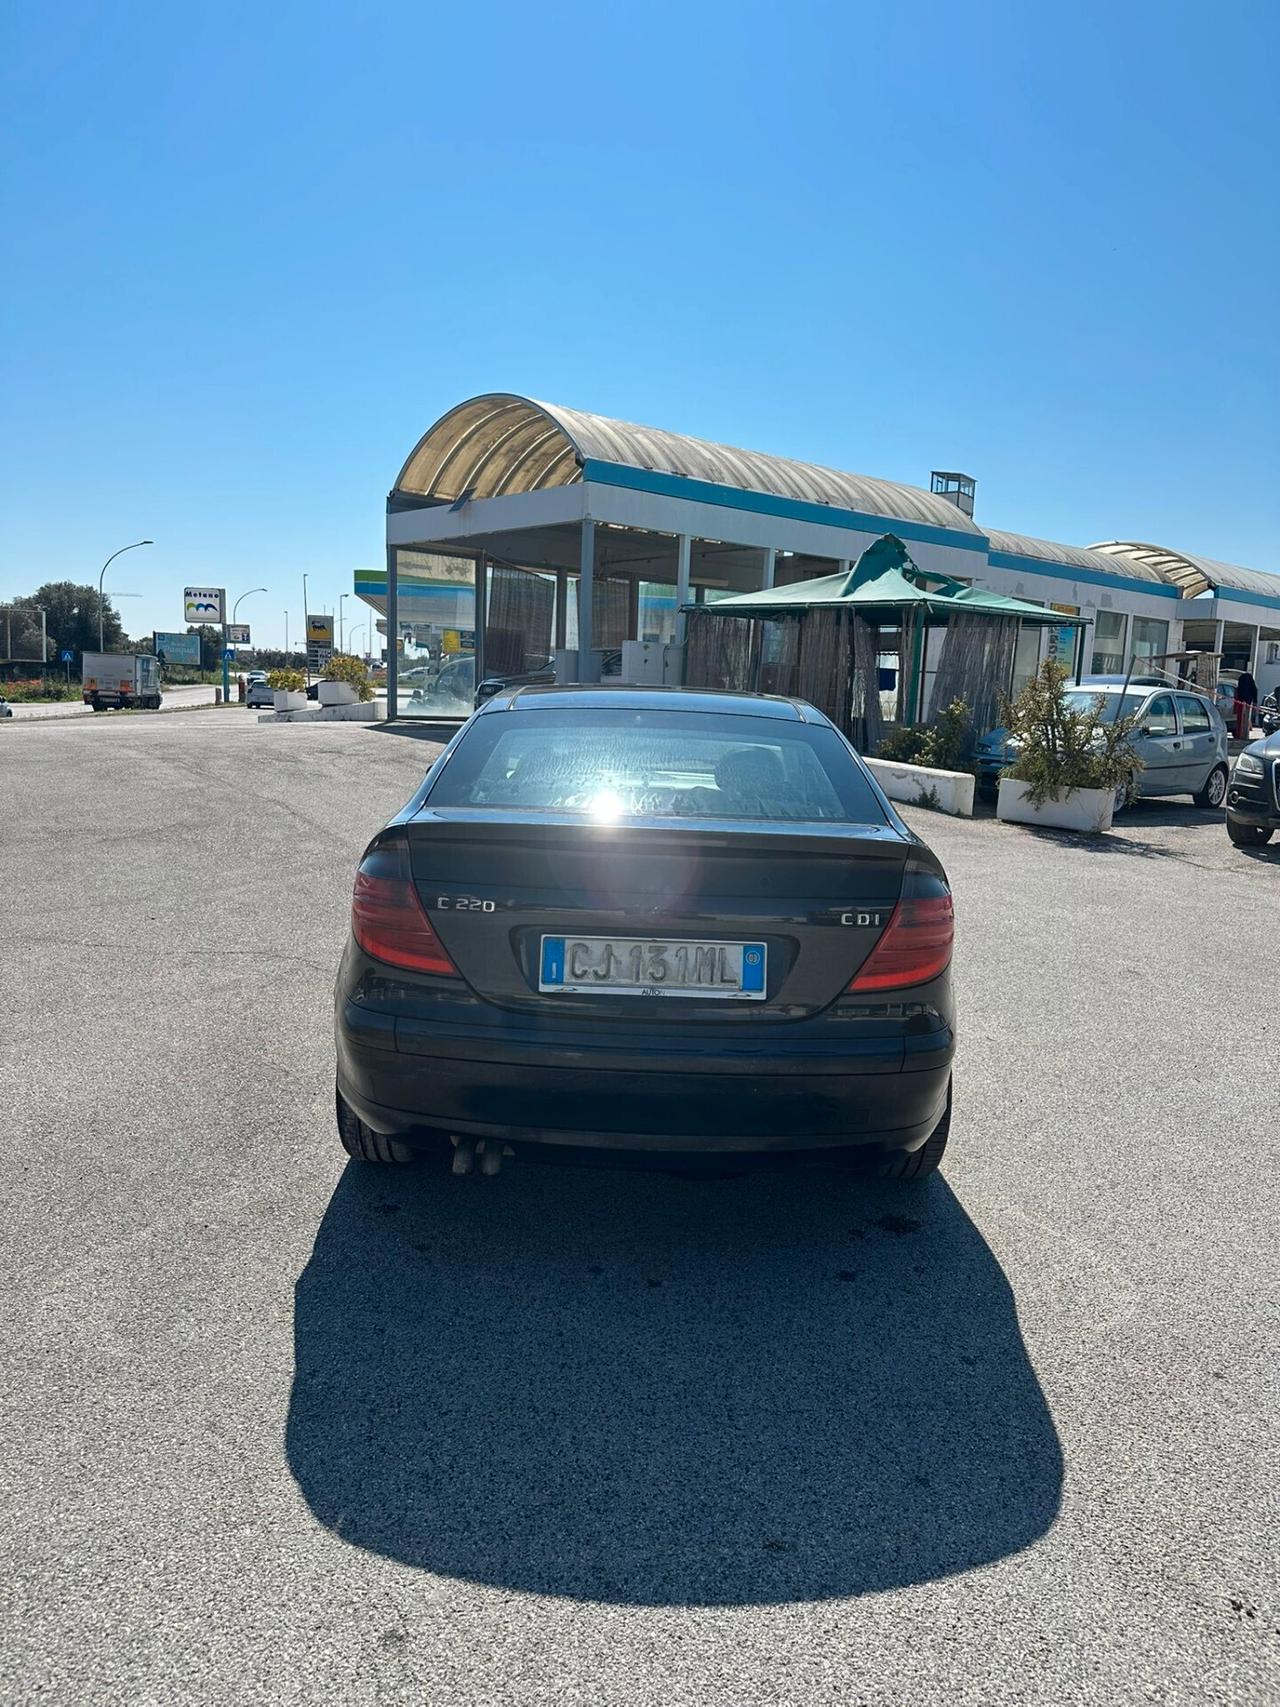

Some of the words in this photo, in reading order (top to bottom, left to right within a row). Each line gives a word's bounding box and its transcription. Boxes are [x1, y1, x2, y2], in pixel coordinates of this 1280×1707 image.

[437, 897, 450, 909] C
[456, 898, 495, 912] 220
[841, 913, 880, 926] CDI
